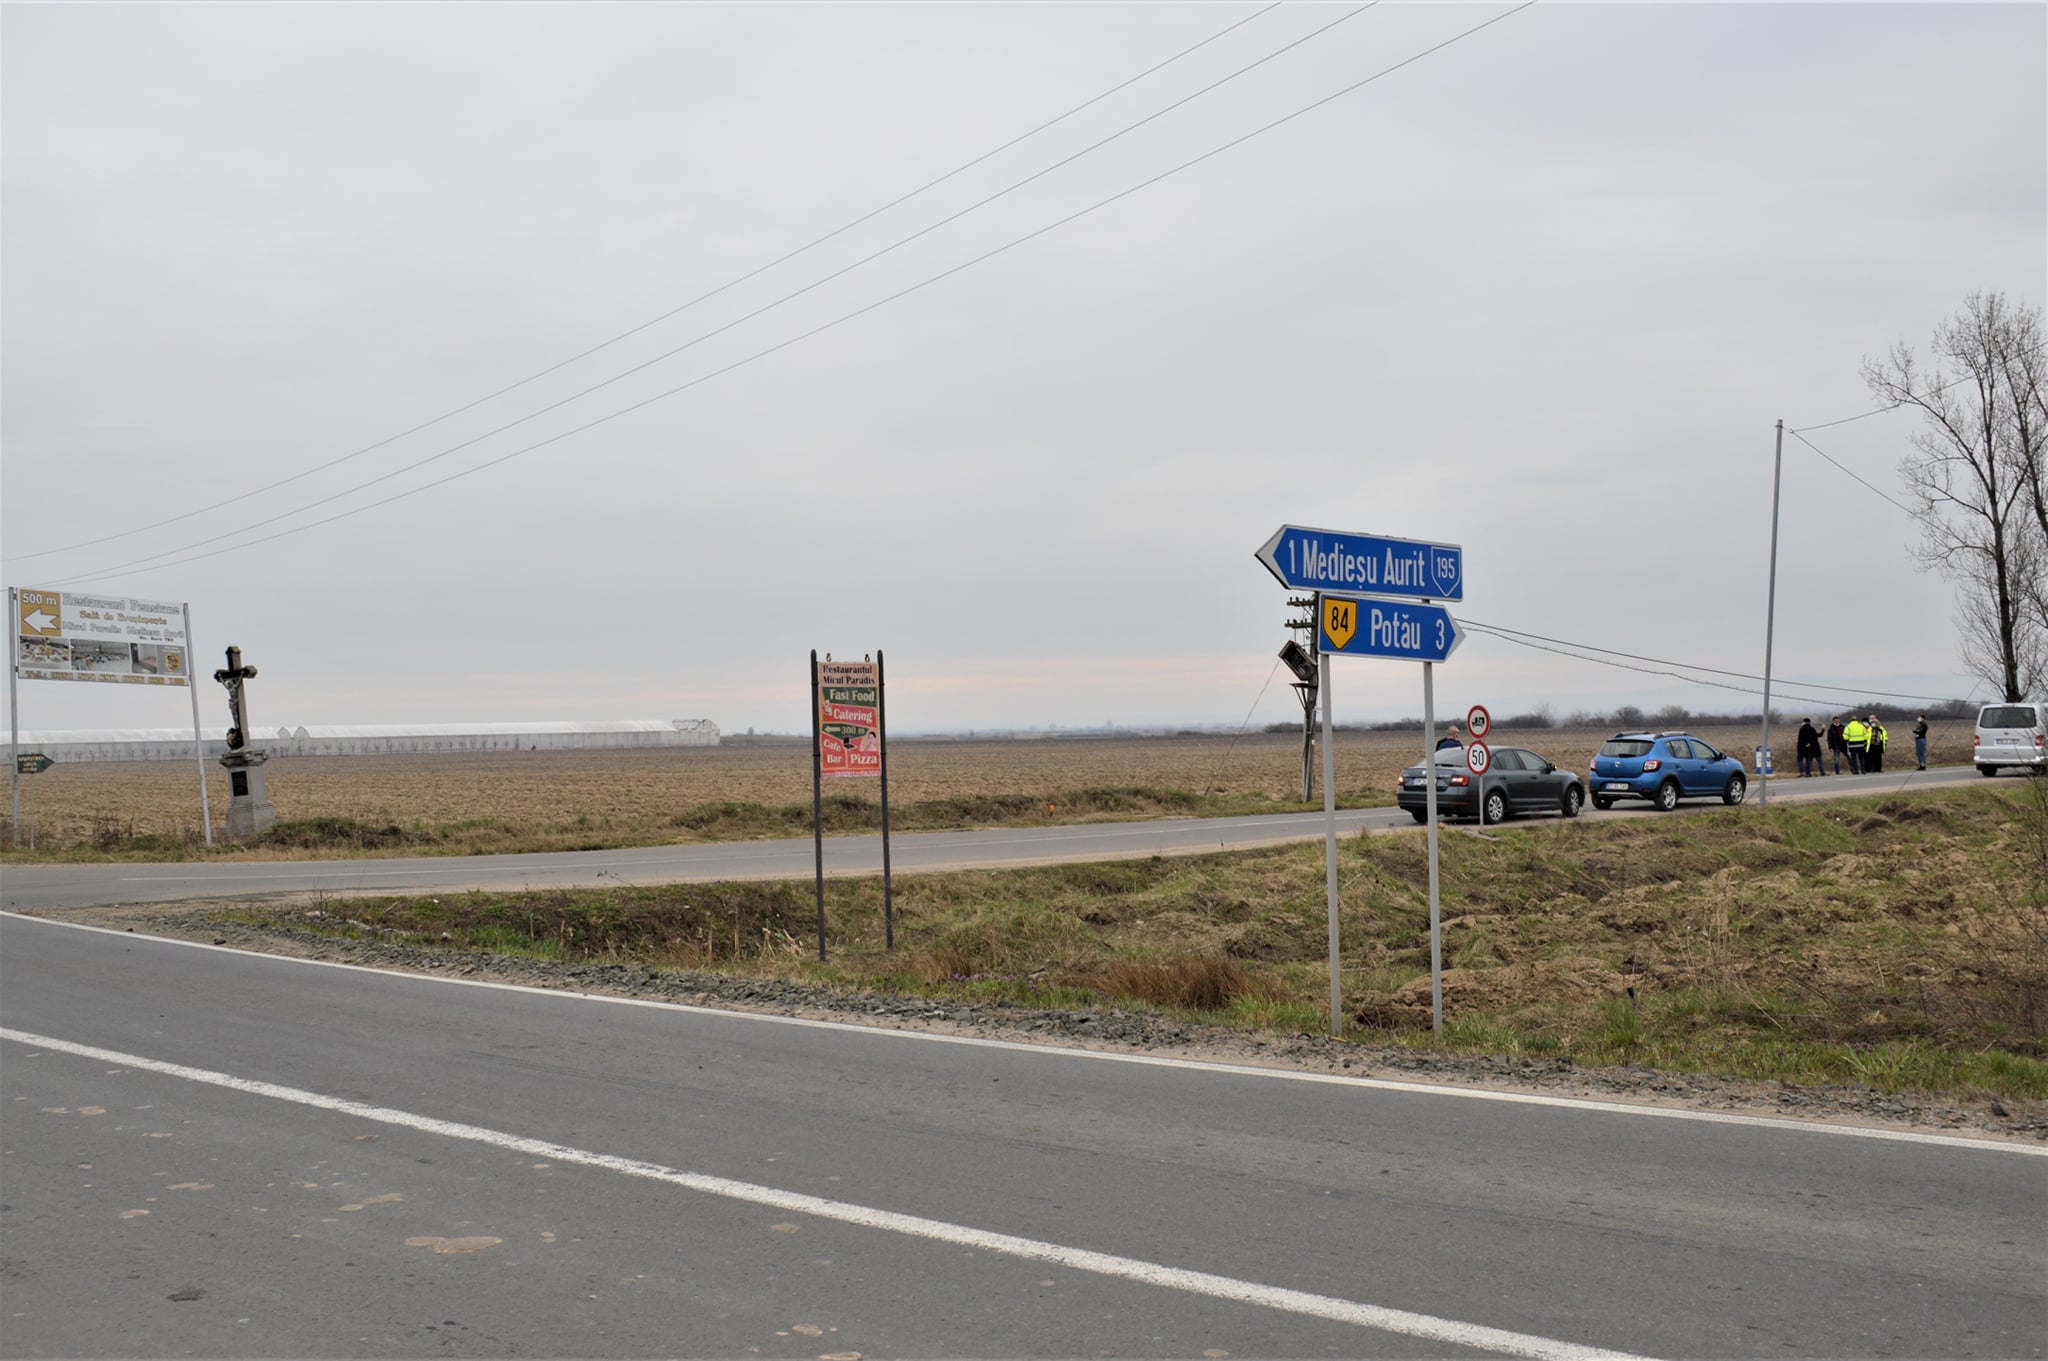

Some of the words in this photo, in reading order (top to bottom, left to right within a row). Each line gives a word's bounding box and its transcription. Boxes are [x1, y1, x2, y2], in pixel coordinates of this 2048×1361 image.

[1288, 539, 1296, 574] 1
[1302, 538, 1377, 589] Medieșu
[1383, 547, 1425, 587] Aurit
[1436, 557, 1456, 580] 195
[23, 592, 43, 605] 500
[46, 597, 57, 605] m
[1331, 606, 1349, 632] 84
[1370, 608, 1421, 650] Potău
[1435, 618, 1446, 651] 3
[823, 665, 872, 674] Restaurantul
[823, 676, 844, 684] Micul
[846, 676, 875, 685] Paradis
[829, 688, 849, 700] Fast
[852, 690, 875, 702] Food
[833, 708, 872, 724] Catering
[827, 754, 842, 763] Bar
[850, 753, 877, 765] Pizza
[1472, 749, 1485, 766] 50
